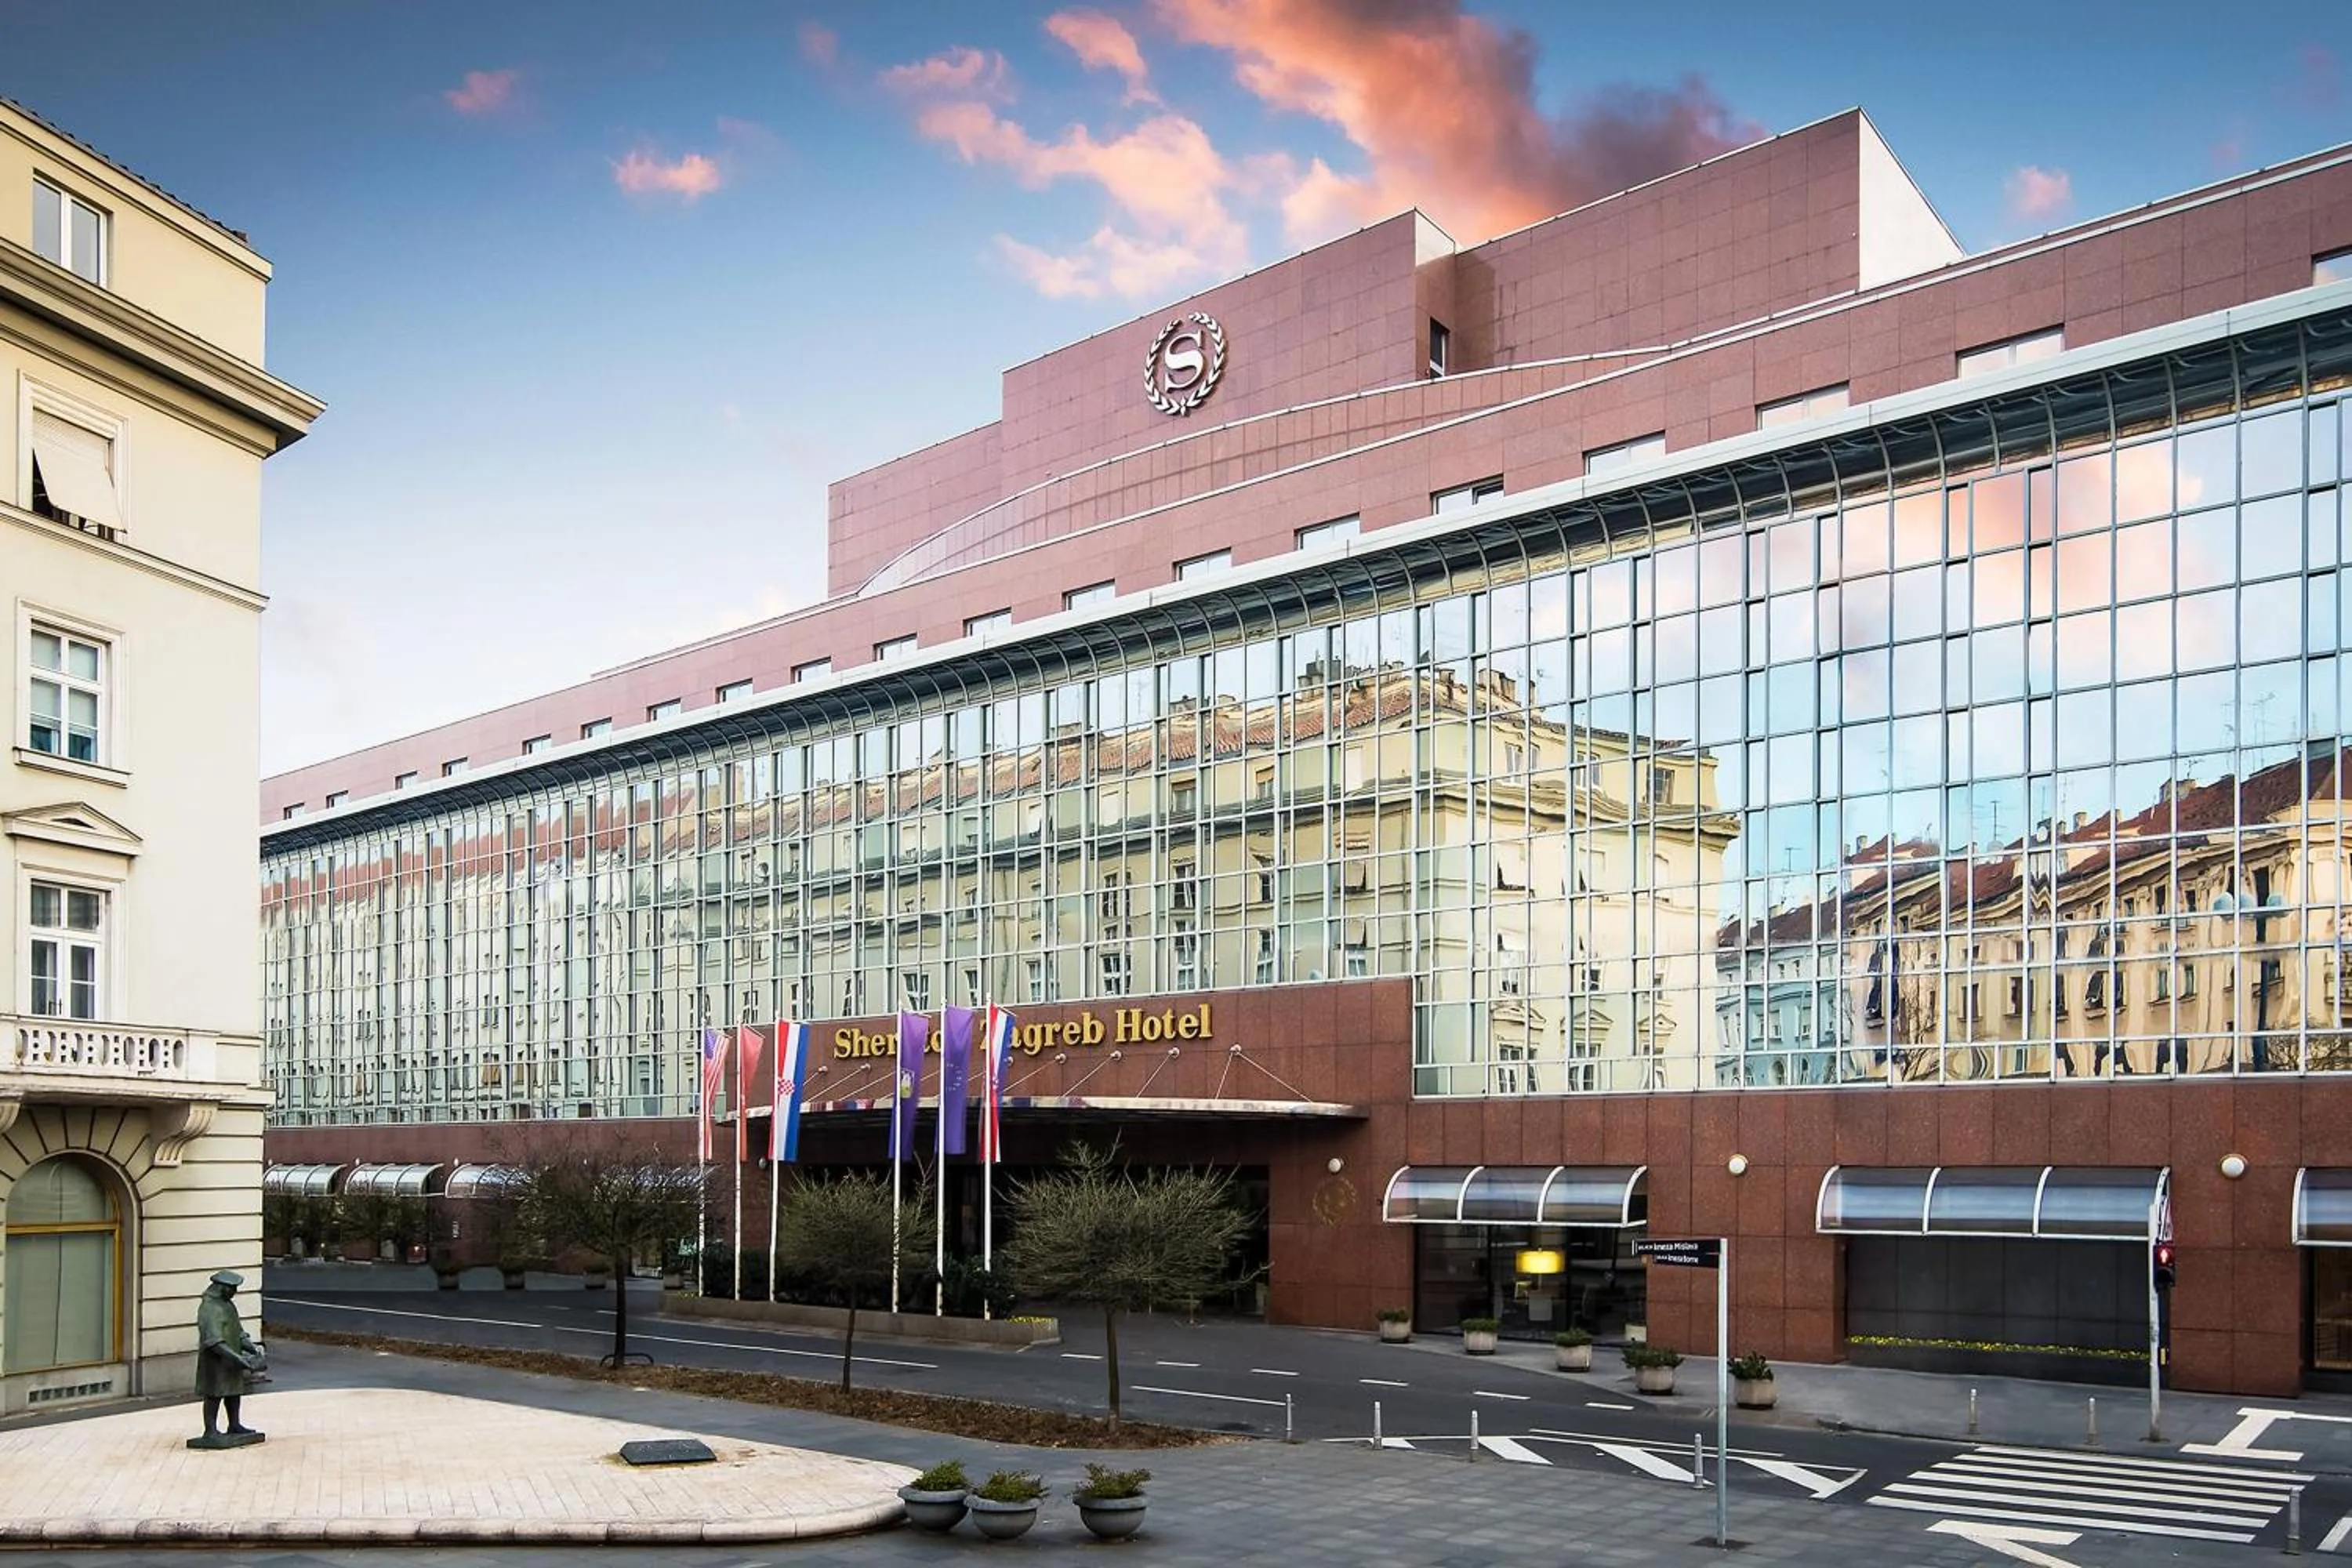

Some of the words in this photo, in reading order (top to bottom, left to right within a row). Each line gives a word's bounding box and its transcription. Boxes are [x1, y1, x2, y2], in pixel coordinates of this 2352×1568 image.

[1164, 329, 1203, 392] S
[834, 1028, 942, 1058] Shero
[1115, 1003, 1214, 1042] Hotel
